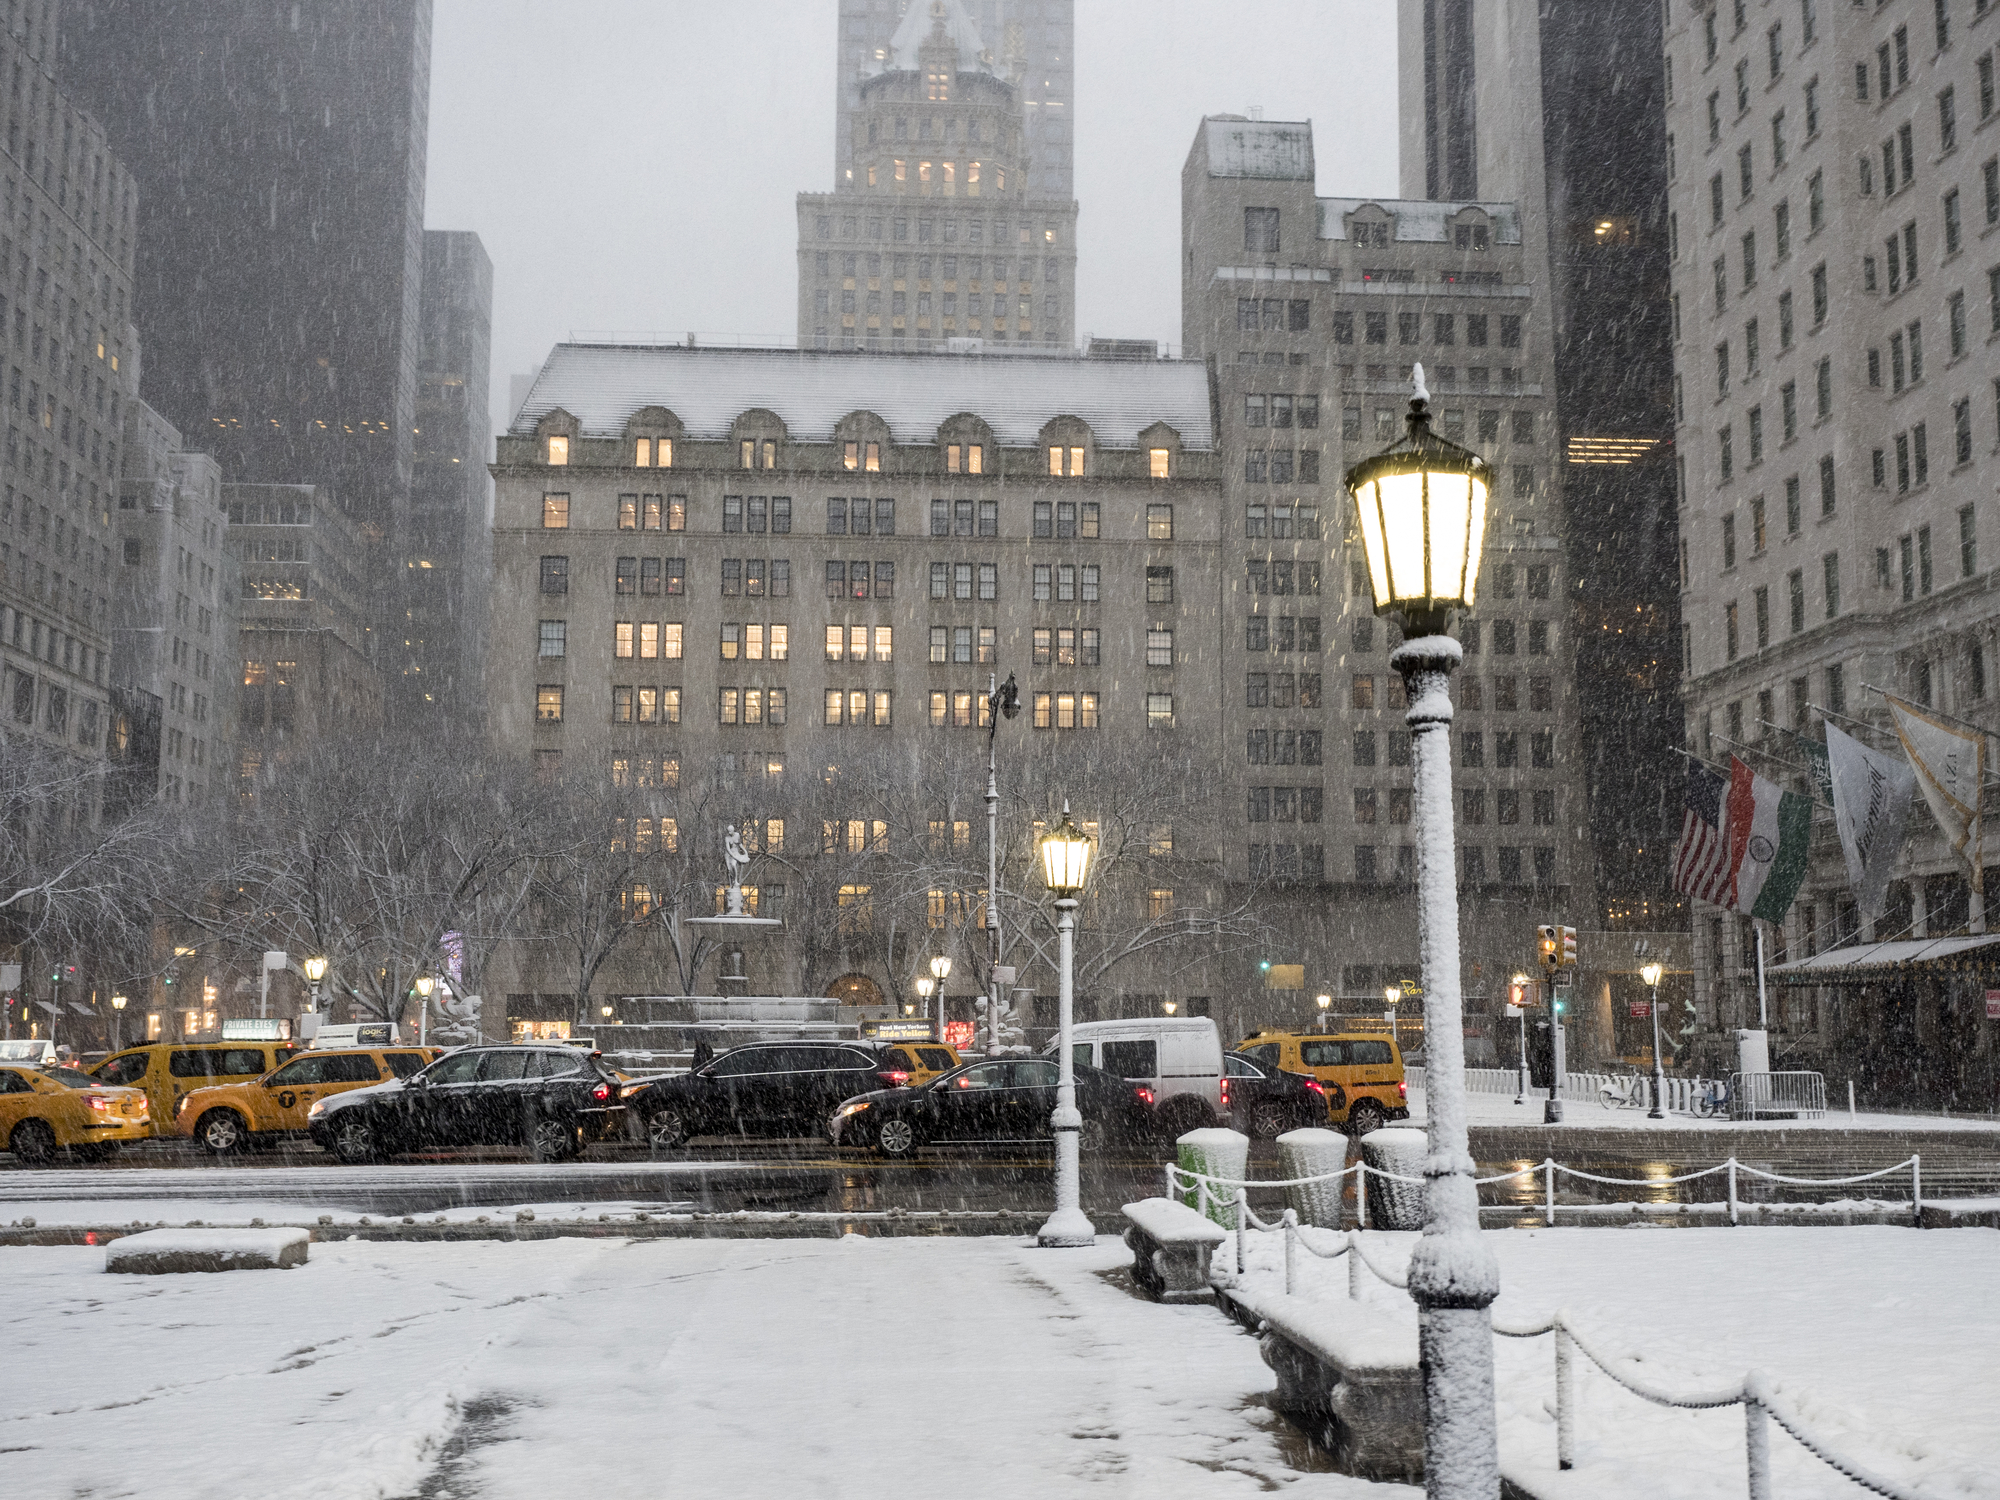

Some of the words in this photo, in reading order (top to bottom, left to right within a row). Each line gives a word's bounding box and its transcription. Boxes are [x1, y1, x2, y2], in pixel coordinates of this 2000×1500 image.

[223, 1020, 253, 1029] PRIVATE
[254, 1020, 273, 1029] EYES
[879, 1030, 900, 1038] Ride
